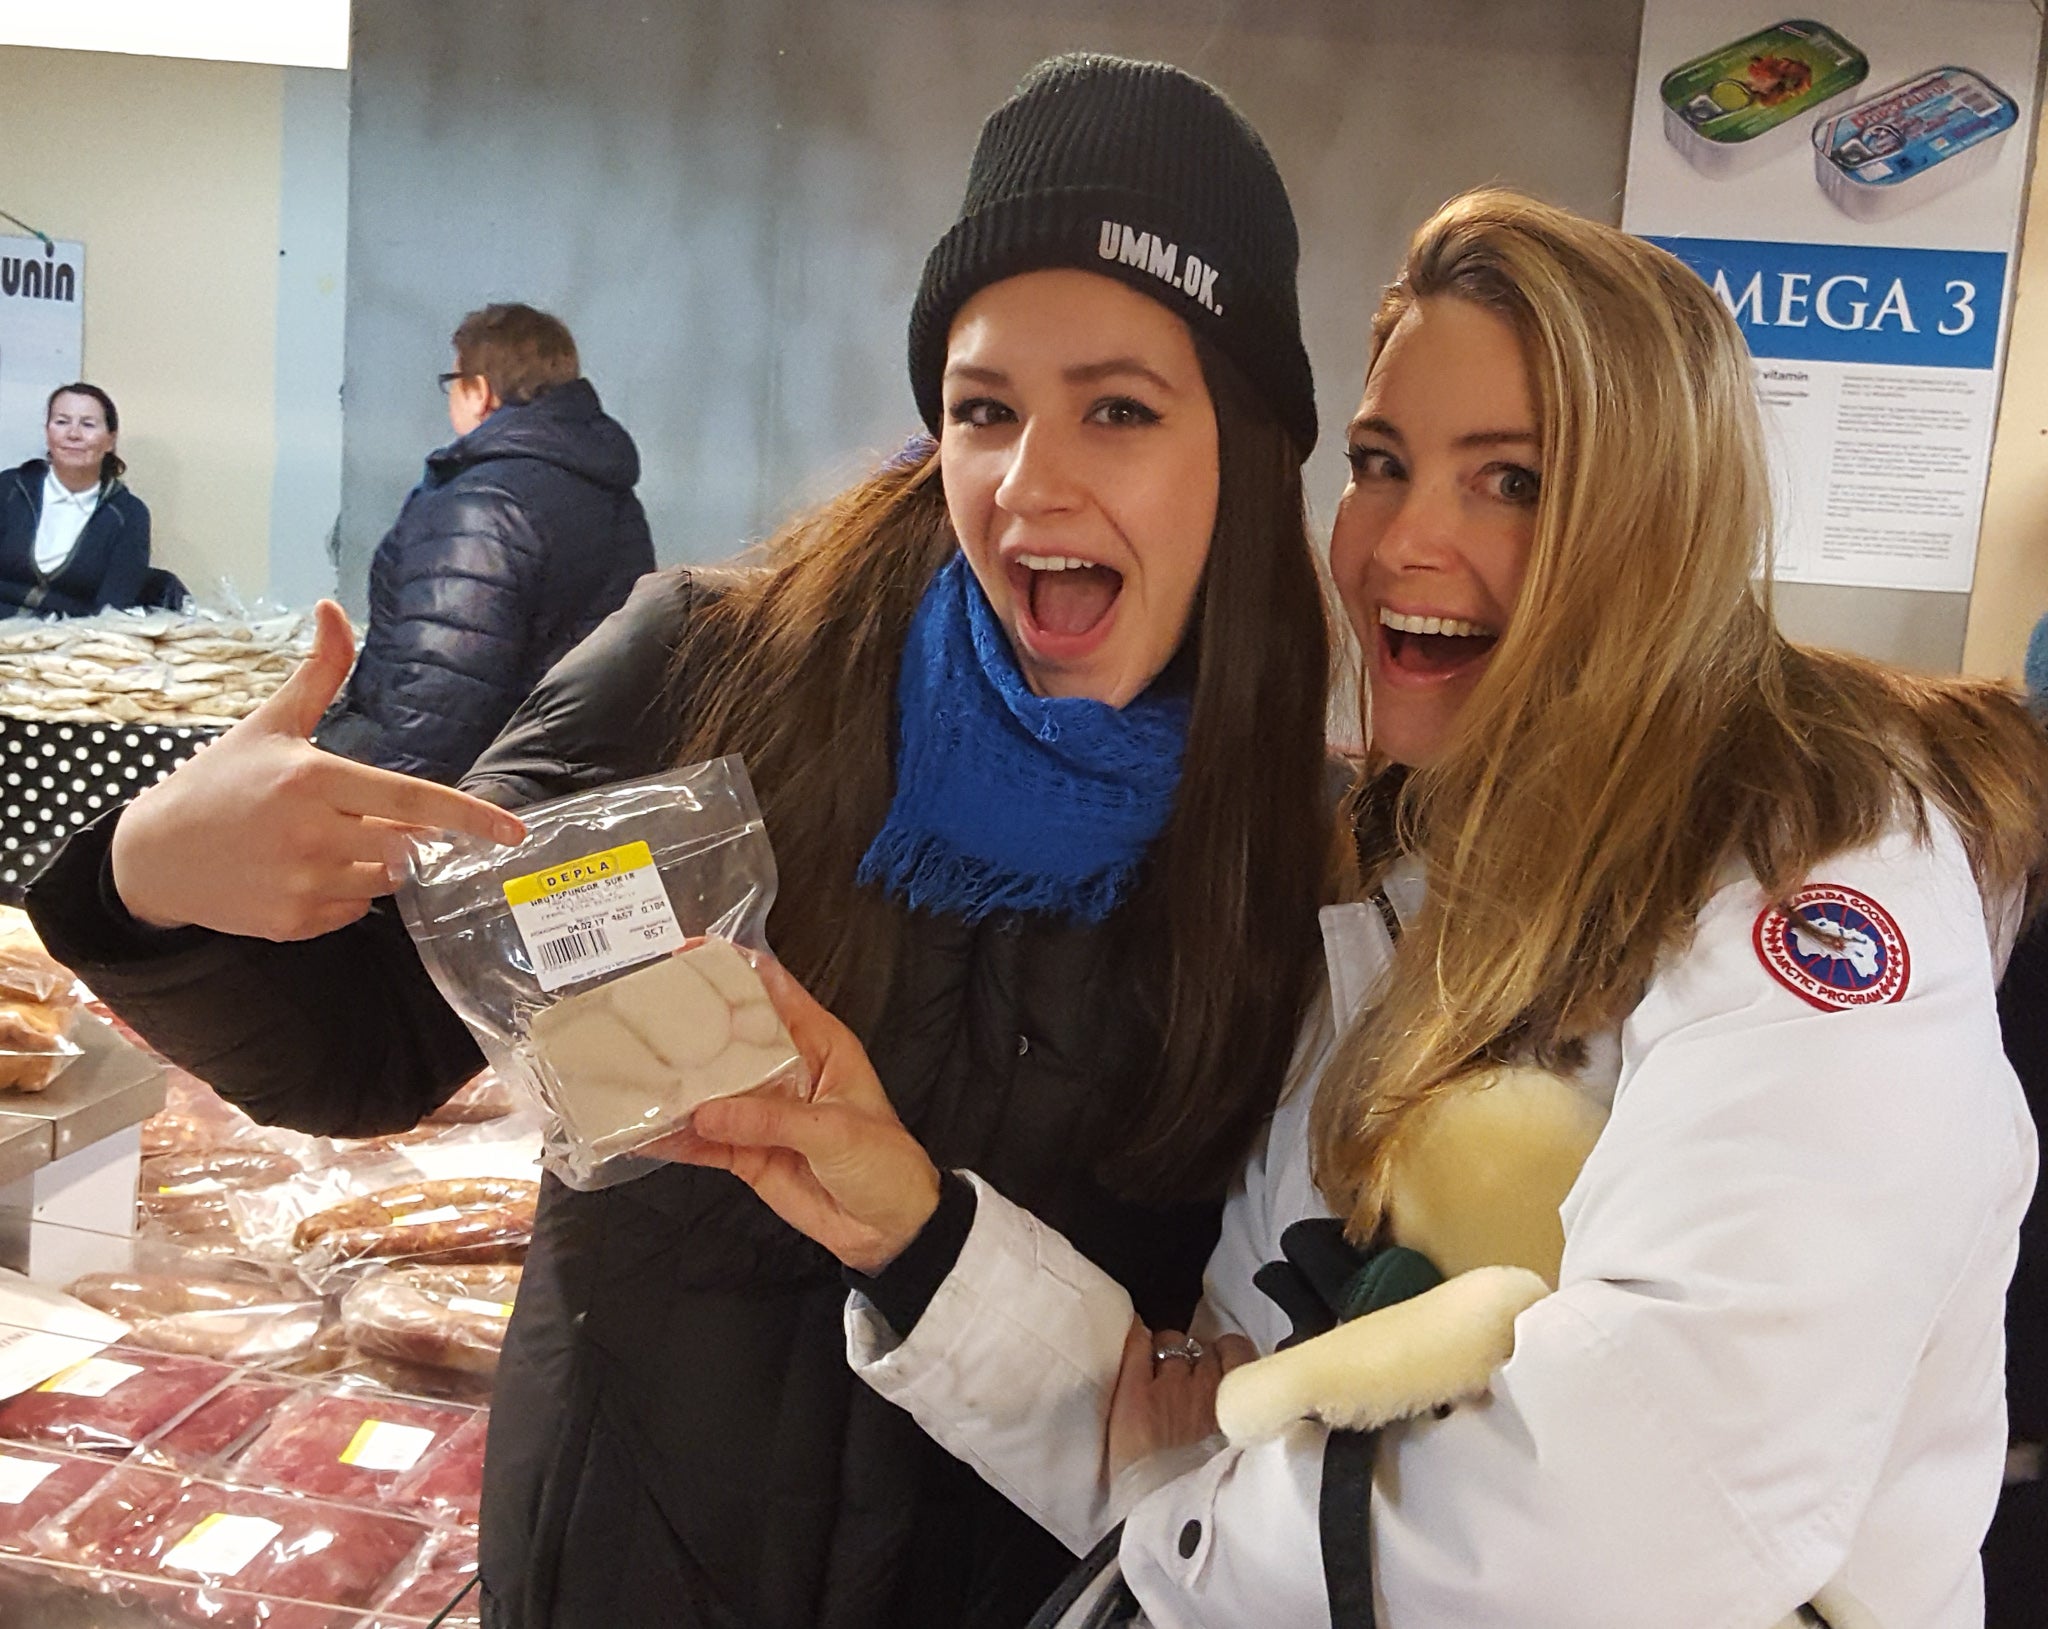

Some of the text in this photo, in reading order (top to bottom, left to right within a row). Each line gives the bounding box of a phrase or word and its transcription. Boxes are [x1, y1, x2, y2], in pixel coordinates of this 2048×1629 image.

[1098, 220, 1224, 317] UMM.OK.
[1713, 268, 1977, 336] MEGA 3
[1763, 370, 1809, 382] vitamin
[547, 861, 610, 886] DEPLA
[1792, 891, 1848, 907] ANADA
[1772, 951, 1884, 1005] ARCTIC PROGRAM
